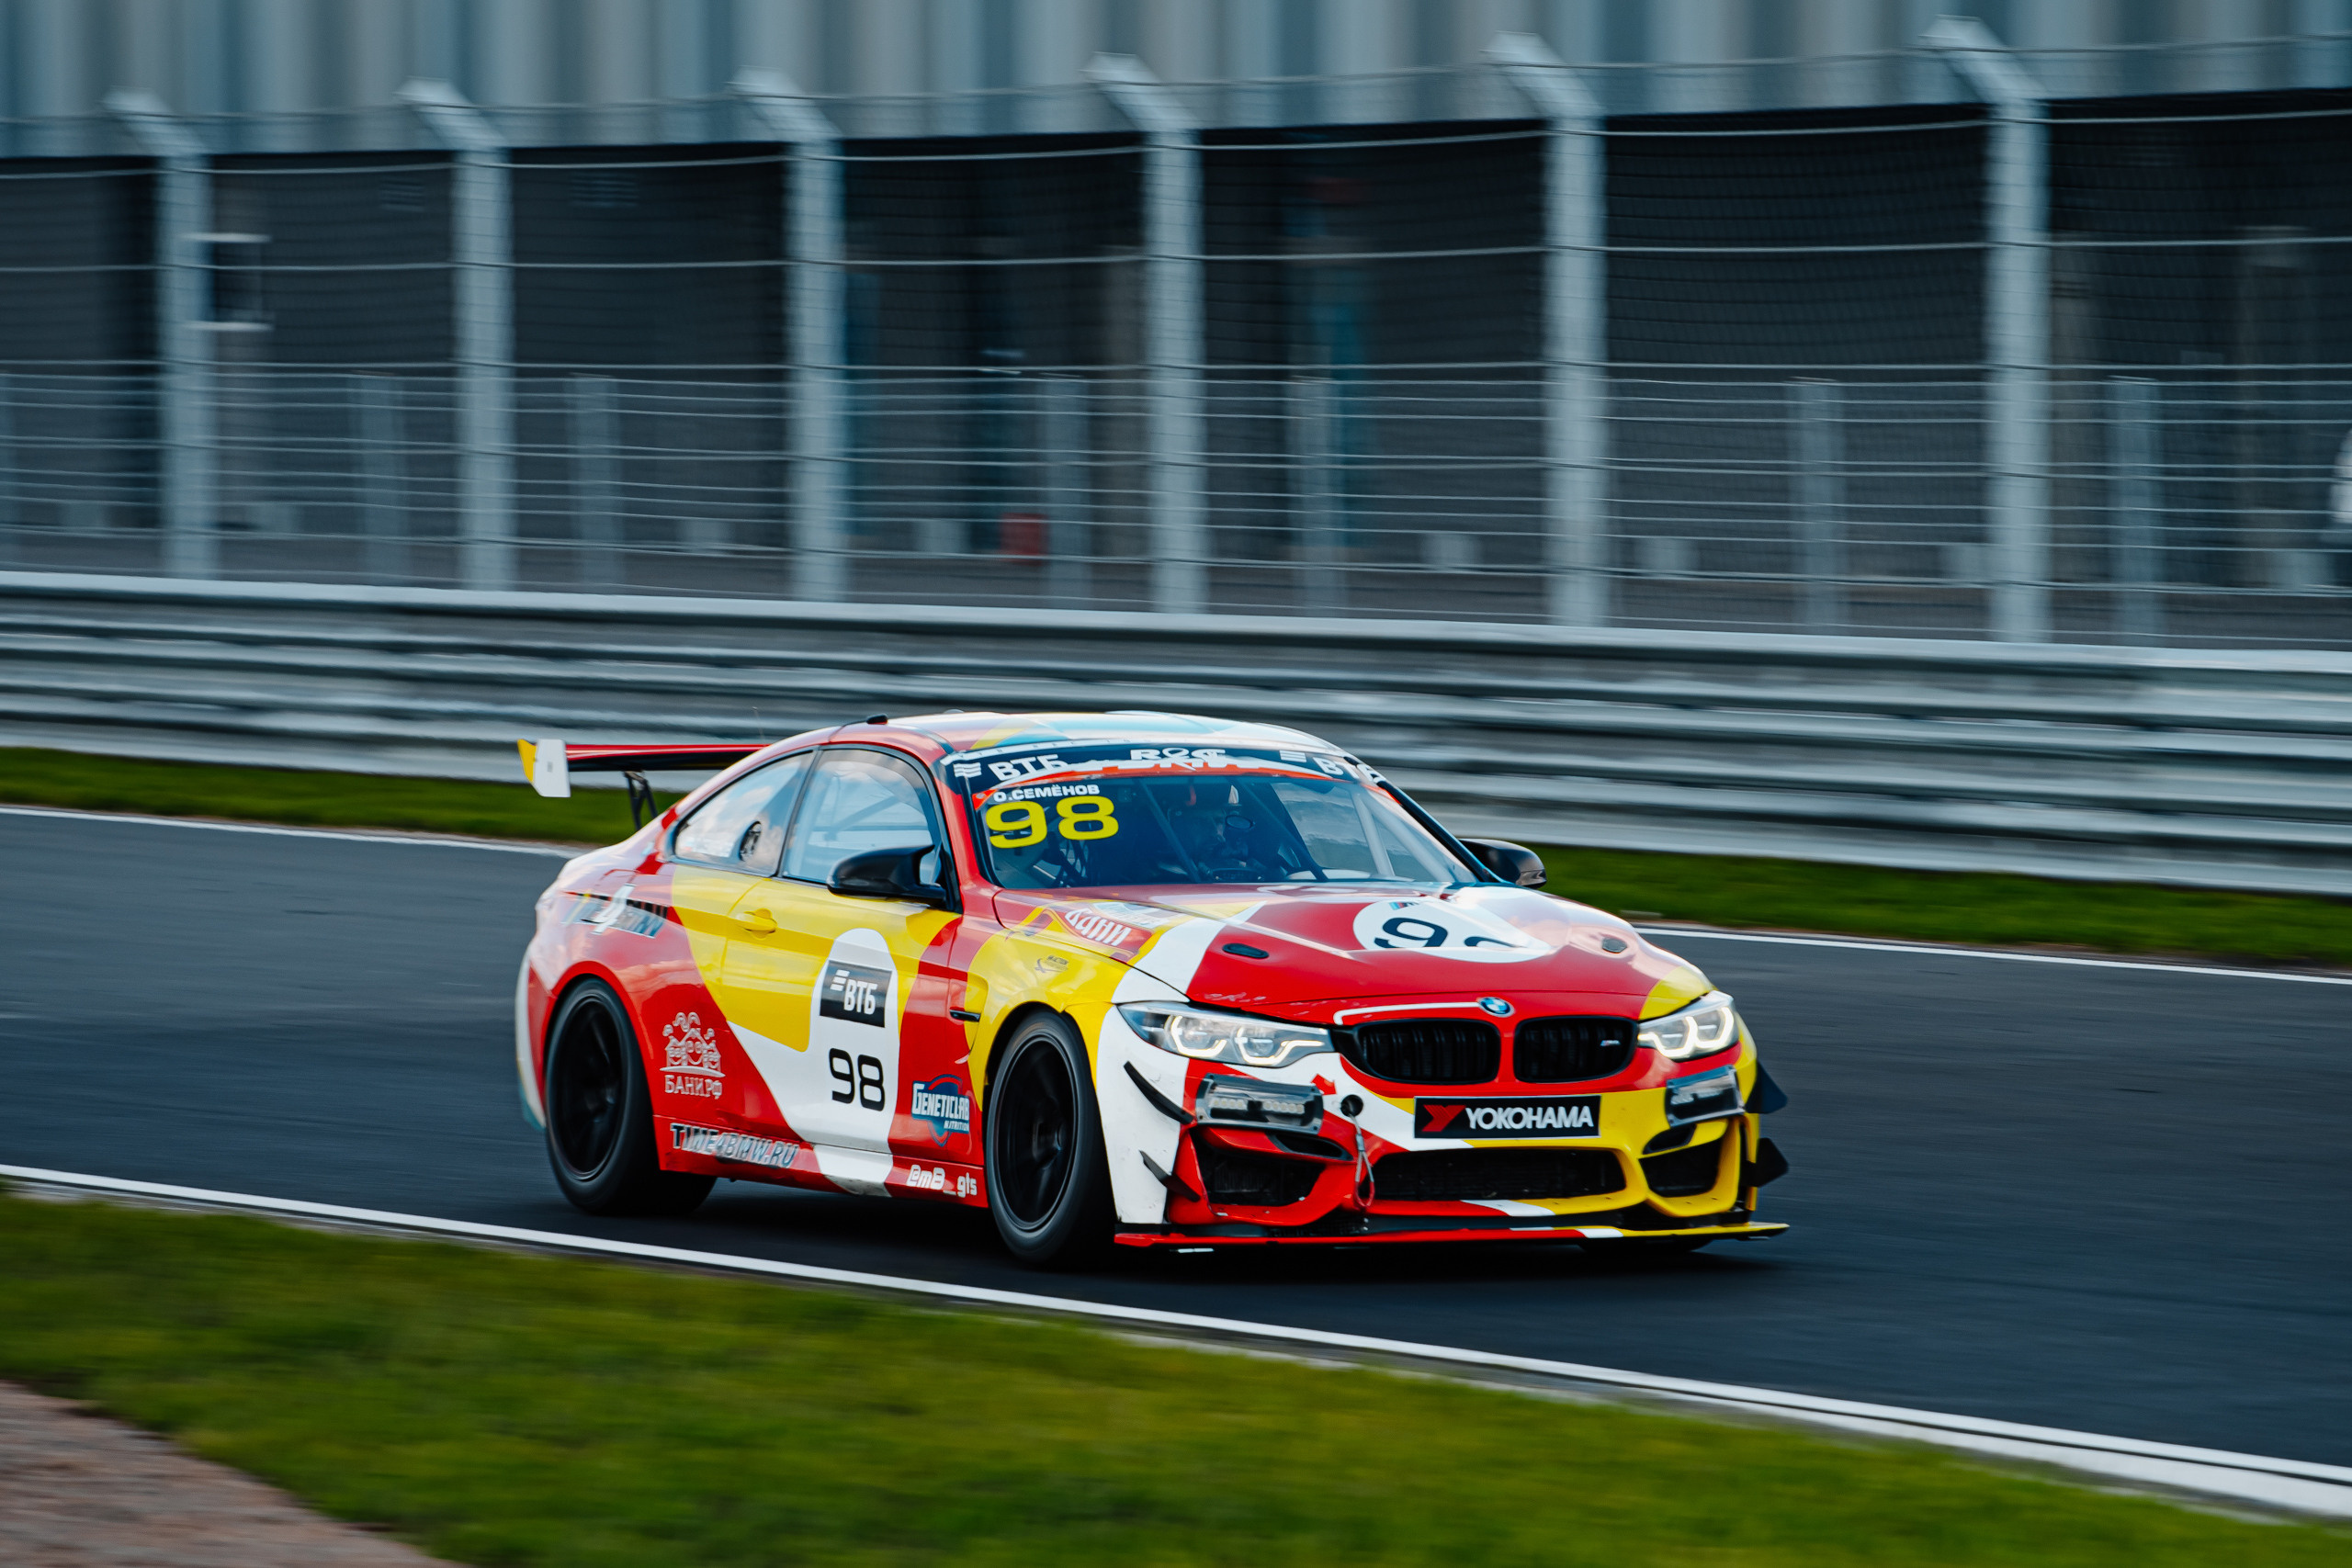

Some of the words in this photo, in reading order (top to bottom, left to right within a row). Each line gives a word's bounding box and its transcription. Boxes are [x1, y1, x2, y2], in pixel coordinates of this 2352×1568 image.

[988, 754, 1069, 781] ВТБ
[993, 784, 1101, 803] О.СЕМЁНОВ
[985, 795, 1119, 849] 98
[843, 978, 878, 1015] ВТБ
[829, 1047, 886, 1111] 98
[1465, 1105, 1595, 1130] YOKOHAMA
